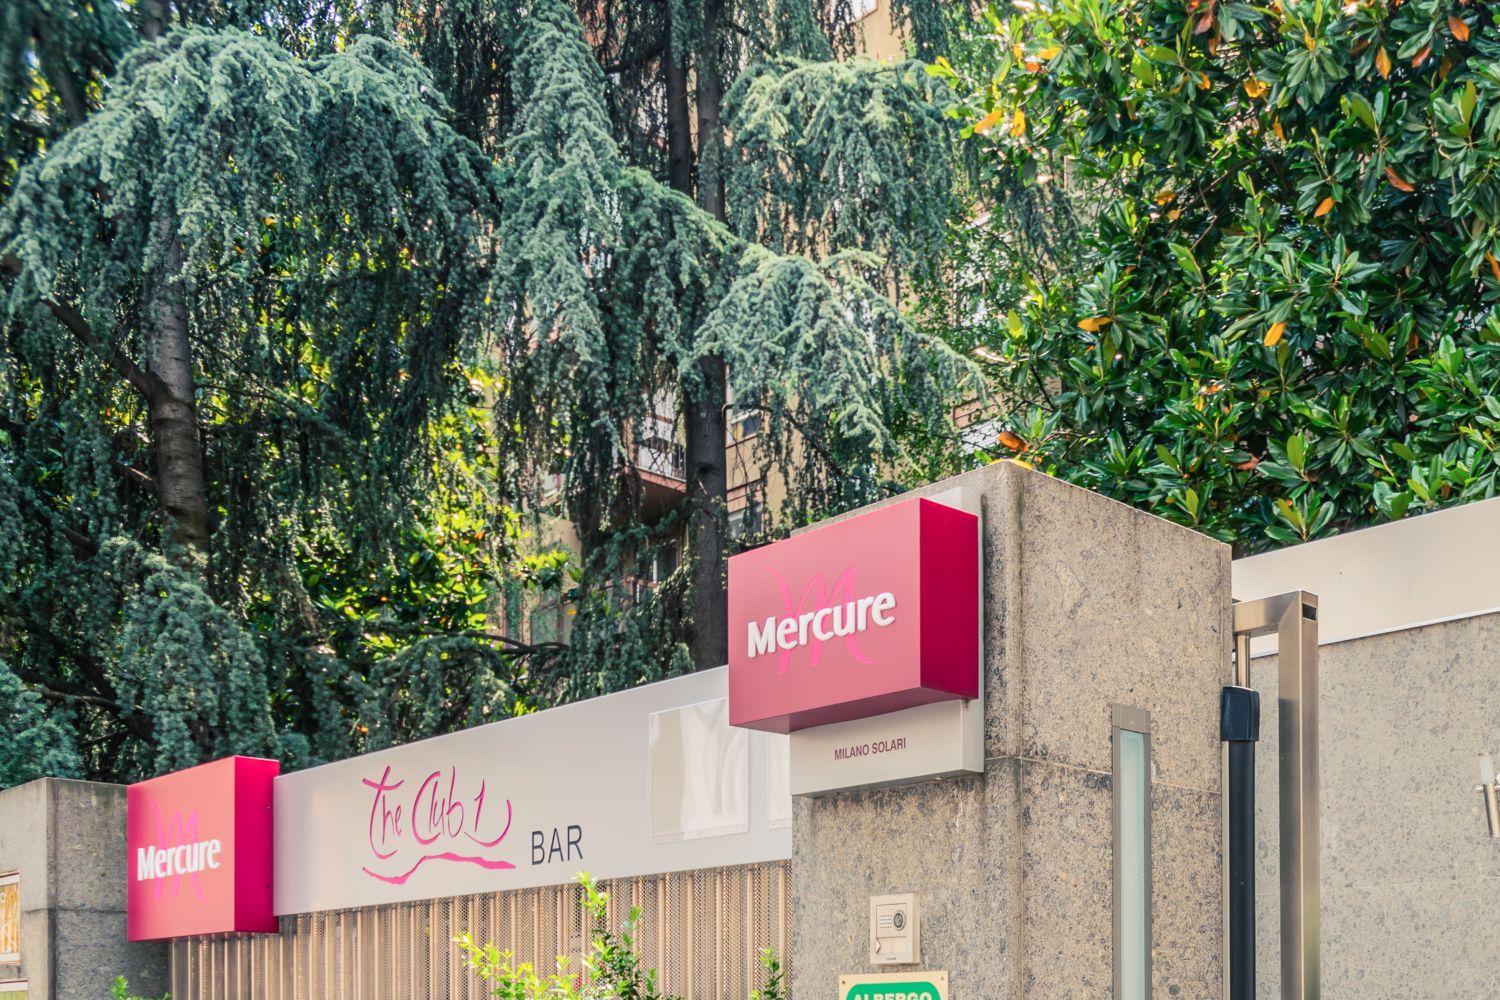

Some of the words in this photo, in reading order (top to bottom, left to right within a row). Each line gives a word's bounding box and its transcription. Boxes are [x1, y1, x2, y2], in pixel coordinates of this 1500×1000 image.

[747, 592, 896, 658] Mercure
[834, 743, 870, 761] MILANO
[871, 737, 907, 755] SOLARI
[411, 765, 465, 846] Club
[137, 838, 221, 881] Mercure
[531, 824, 584, 866] BAR
